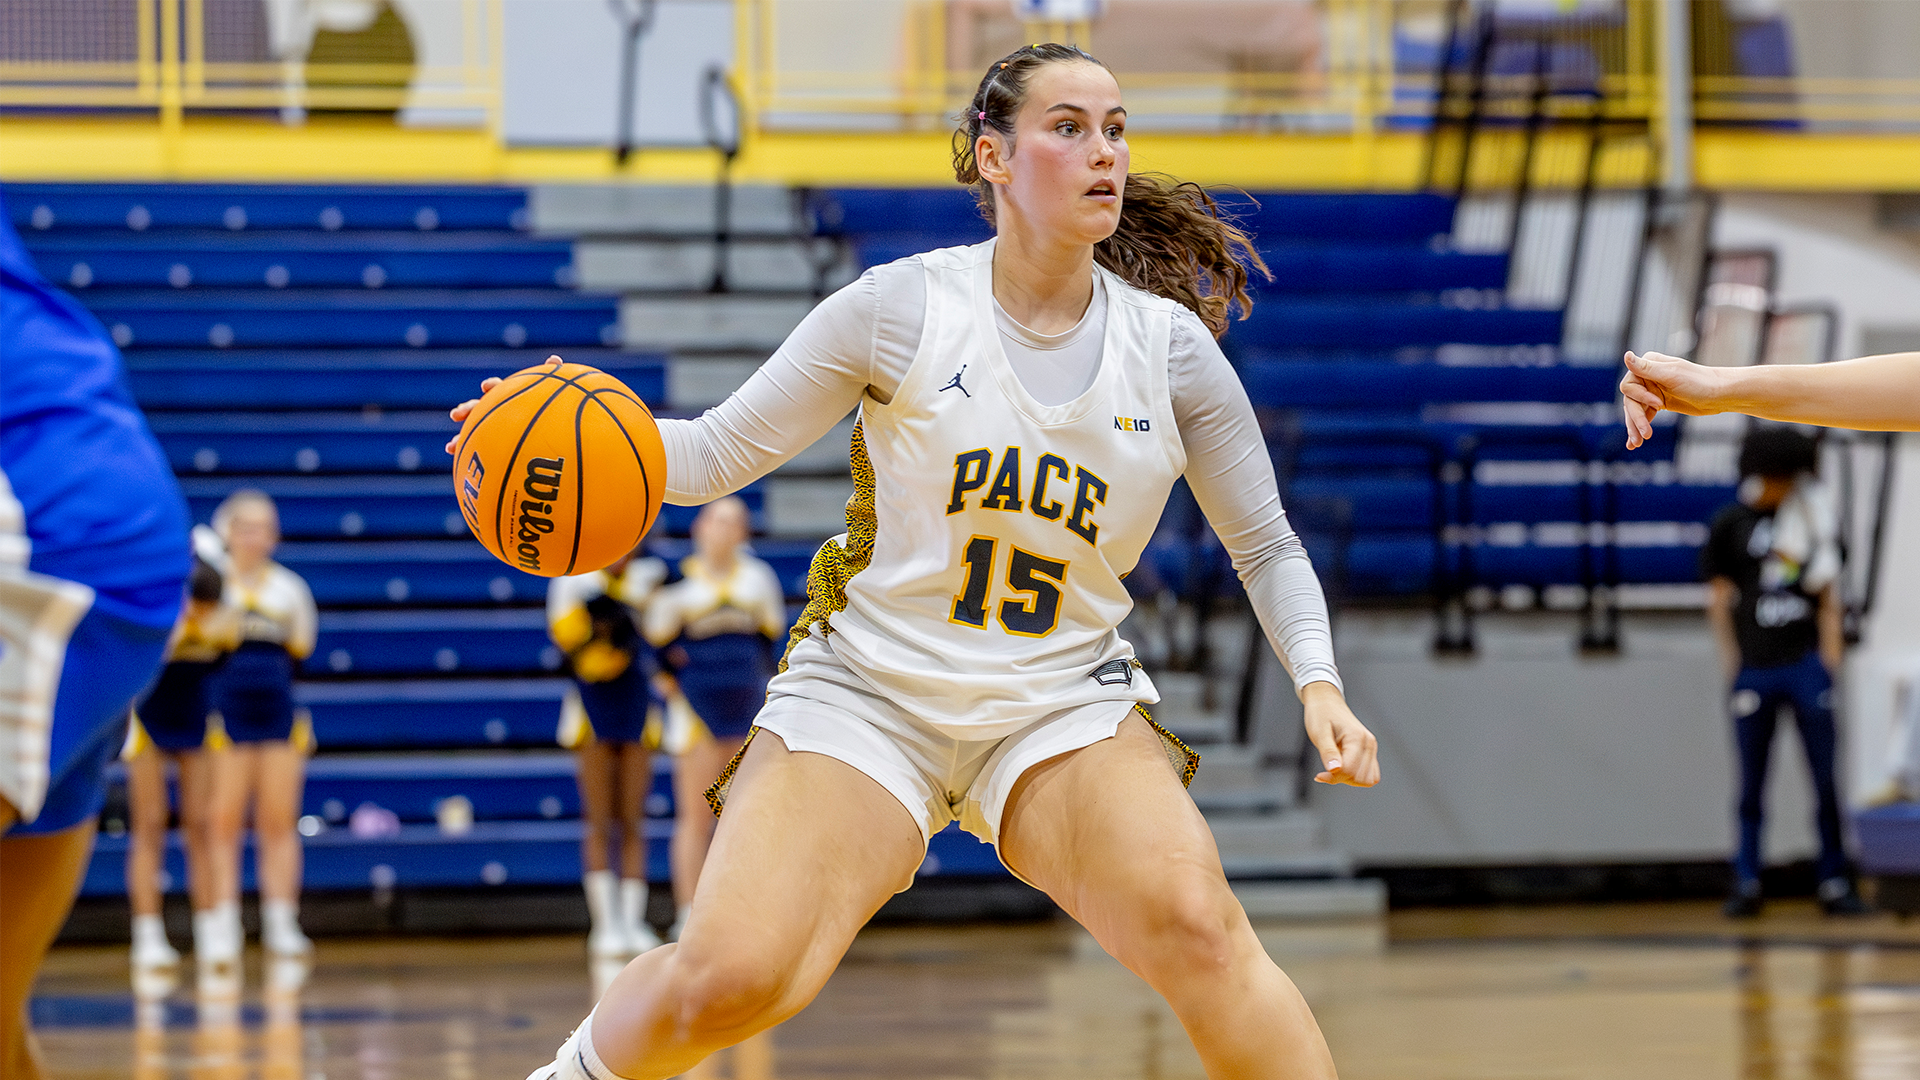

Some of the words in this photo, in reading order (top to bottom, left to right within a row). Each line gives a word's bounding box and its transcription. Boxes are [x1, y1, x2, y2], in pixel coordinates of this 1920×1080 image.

[1113, 415, 1151, 432] NE10
[517, 456, 565, 571] Wilson
[946, 446, 1109, 548] PACE
[948, 534, 1071, 639] 15
